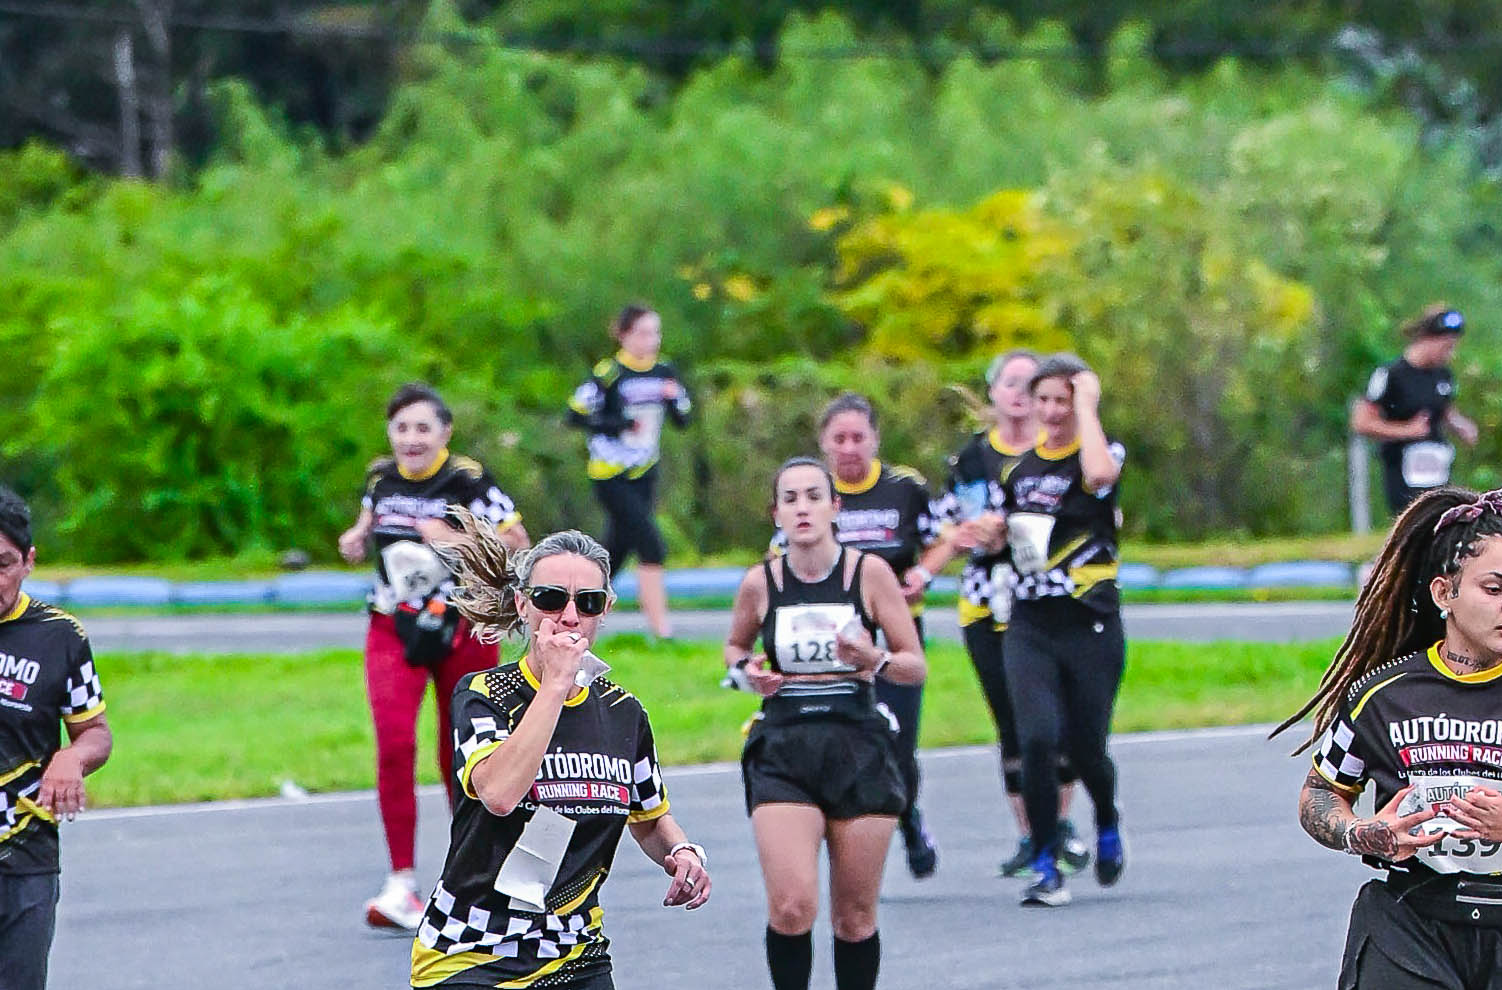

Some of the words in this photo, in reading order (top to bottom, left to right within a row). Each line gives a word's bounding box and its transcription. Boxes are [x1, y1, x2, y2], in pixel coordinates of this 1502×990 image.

[1409, 745, 1469, 763] RUNNING
[536, 746, 632, 785] TÓDROMO
[536, 783, 588, 800] RUNNING
[590, 783, 621, 801] RACE
